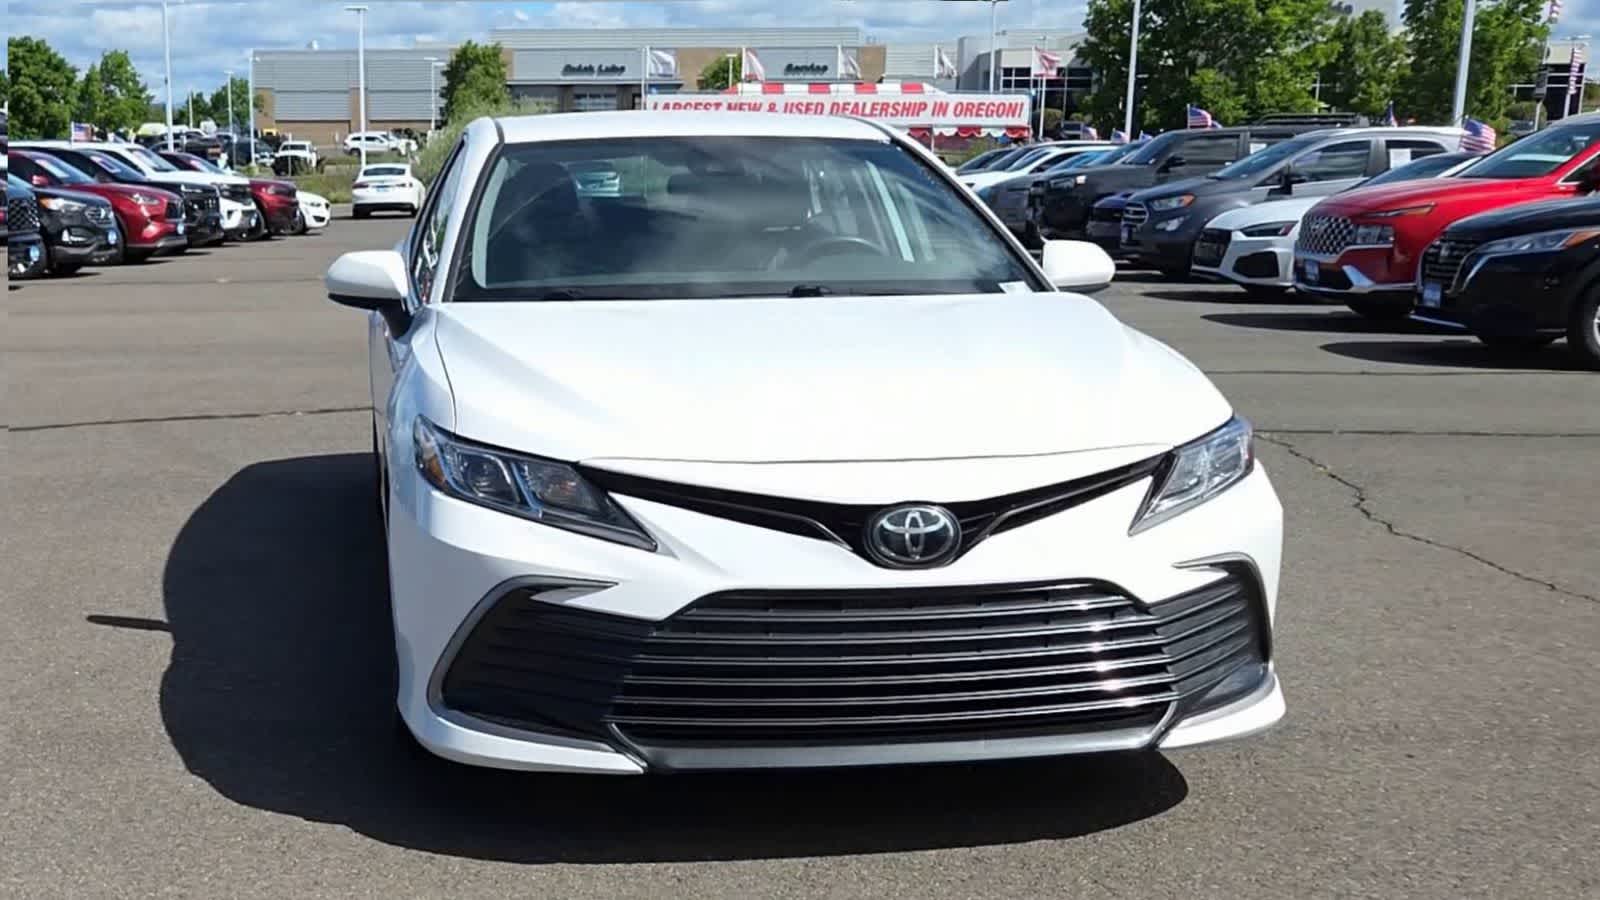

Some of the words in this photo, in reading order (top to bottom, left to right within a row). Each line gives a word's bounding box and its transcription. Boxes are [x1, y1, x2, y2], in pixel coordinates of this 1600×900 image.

[783, 102, 824, 116] USED
[830, 102, 928, 118] DEALERSHIP
[931, 102, 948, 118] IN
[953, 102, 1024, 118] OREGON!
